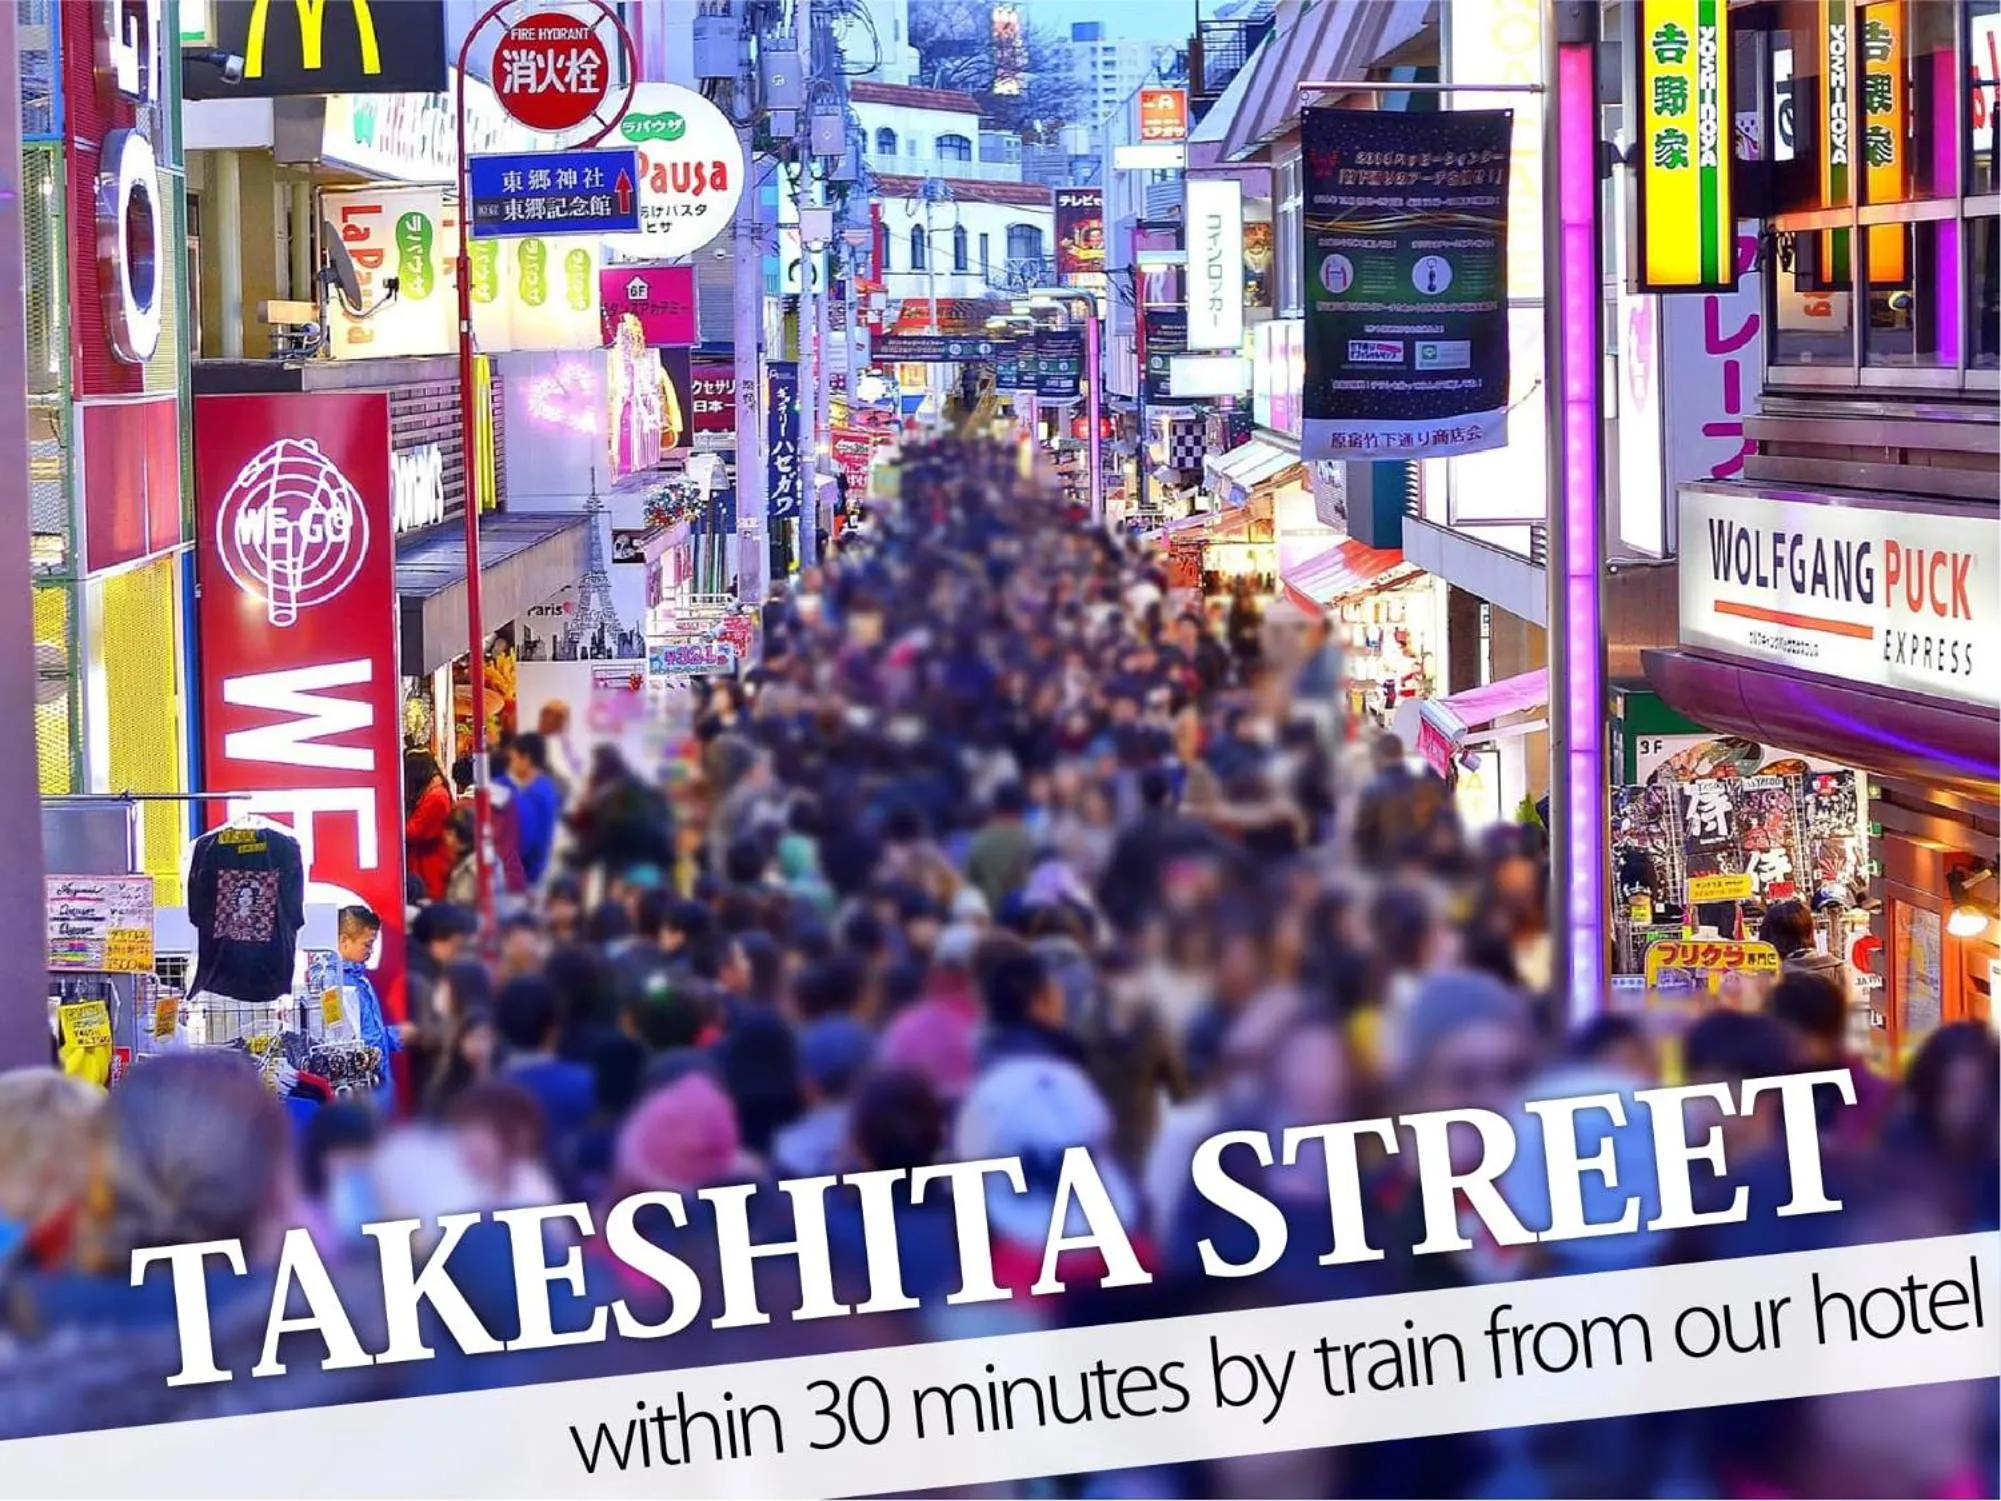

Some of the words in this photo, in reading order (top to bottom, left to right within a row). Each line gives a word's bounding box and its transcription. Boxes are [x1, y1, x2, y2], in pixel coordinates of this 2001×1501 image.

[511, 27, 536, 41] FIRE
[538, 27, 589, 41] HYDRANT
[502, 48, 601, 95] 消火栓
[1652, 23, 1689, 169] 吉野家
[622, 119, 683, 133] ラパウザ
[502, 167, 605, 193] 東郷神社
[503, 195, 612, 221] 東郷記念館
[1331, 424, 1484, 449] 原宿竹下通り商店会
[1708, 518, 1875, 605] WOLFGANG
[1884, 539, 1974, 621] PUCK
[1883, 629, 1974, 677] EXPRESS
